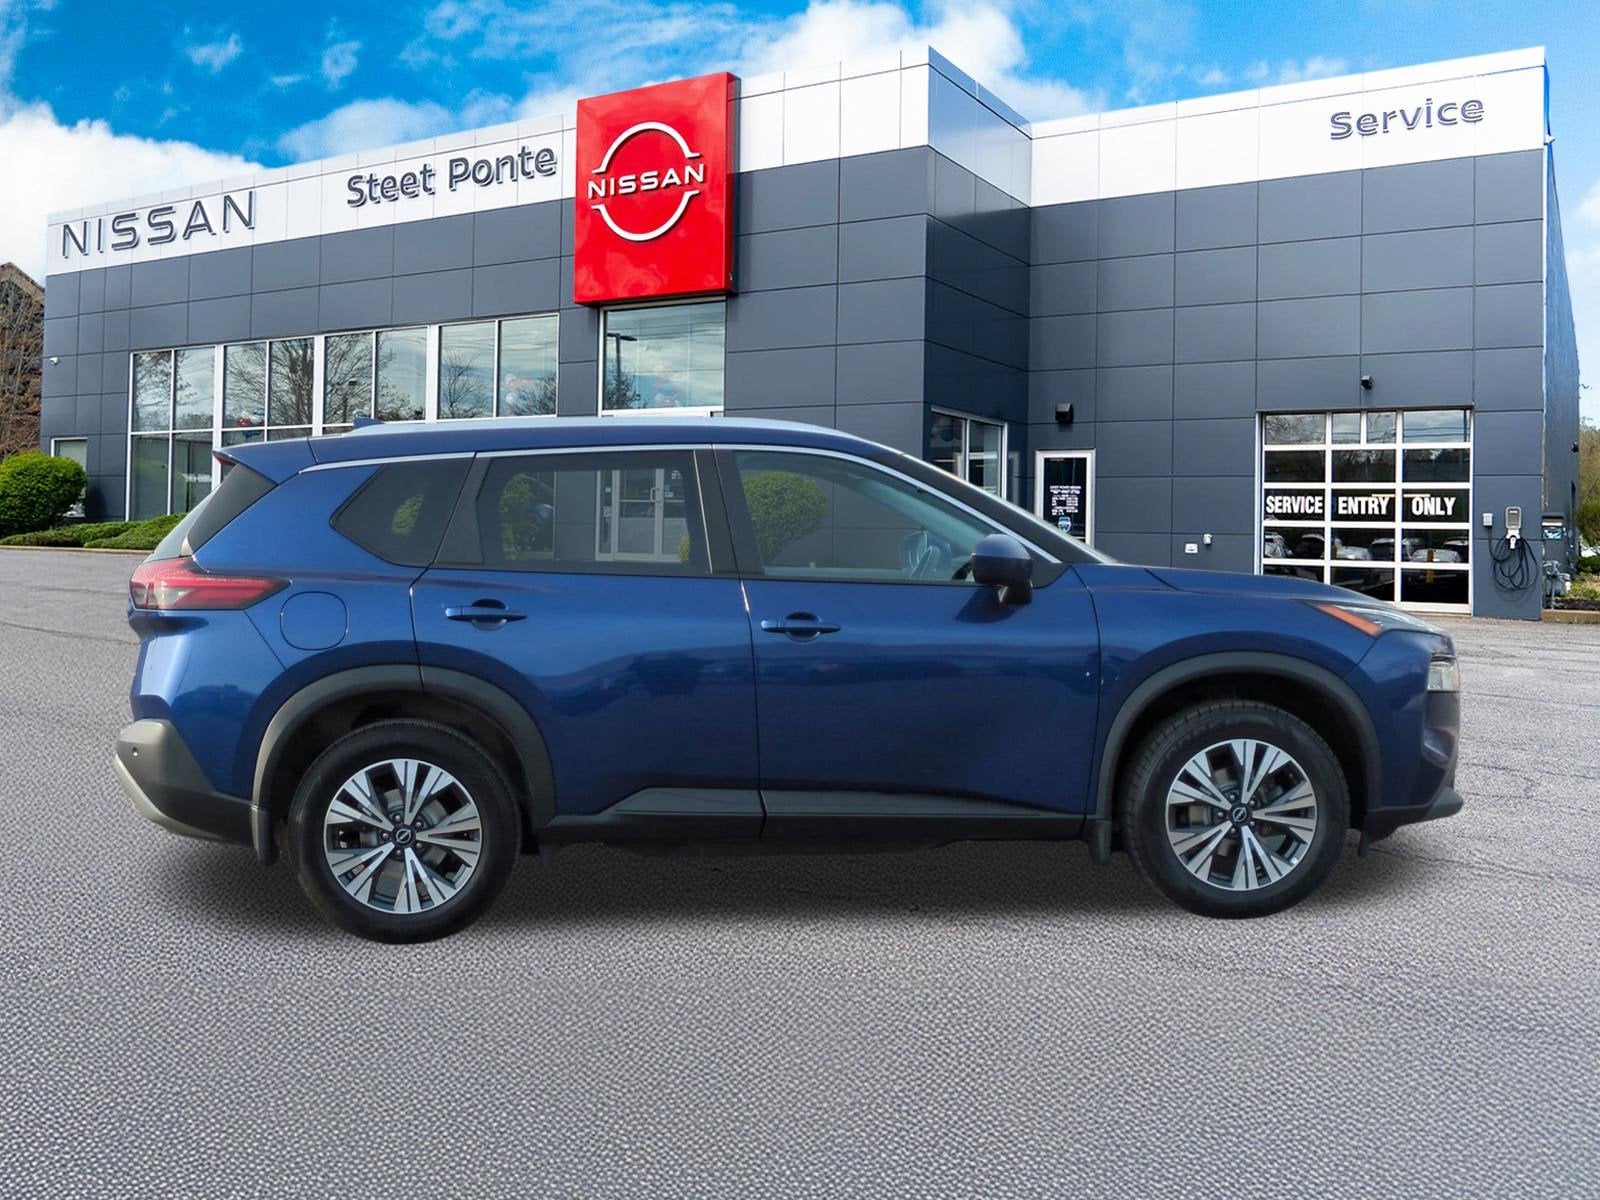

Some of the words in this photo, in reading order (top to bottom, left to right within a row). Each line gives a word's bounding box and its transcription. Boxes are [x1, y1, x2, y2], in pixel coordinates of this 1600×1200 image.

[1330, 97, 1484, 140] Service
[347, 162, 436, 208] Steet
[449, 145, 558, 192] Ponte
[587, 163, 705, 200] NISSAN
[62, 190, 256, 260] NISSAN
[1265, 495, 1323, 514] SERVICE
[1337, 496, 1389, 515] ENTRY
[1411, 496, 1456, 516] ONLY
